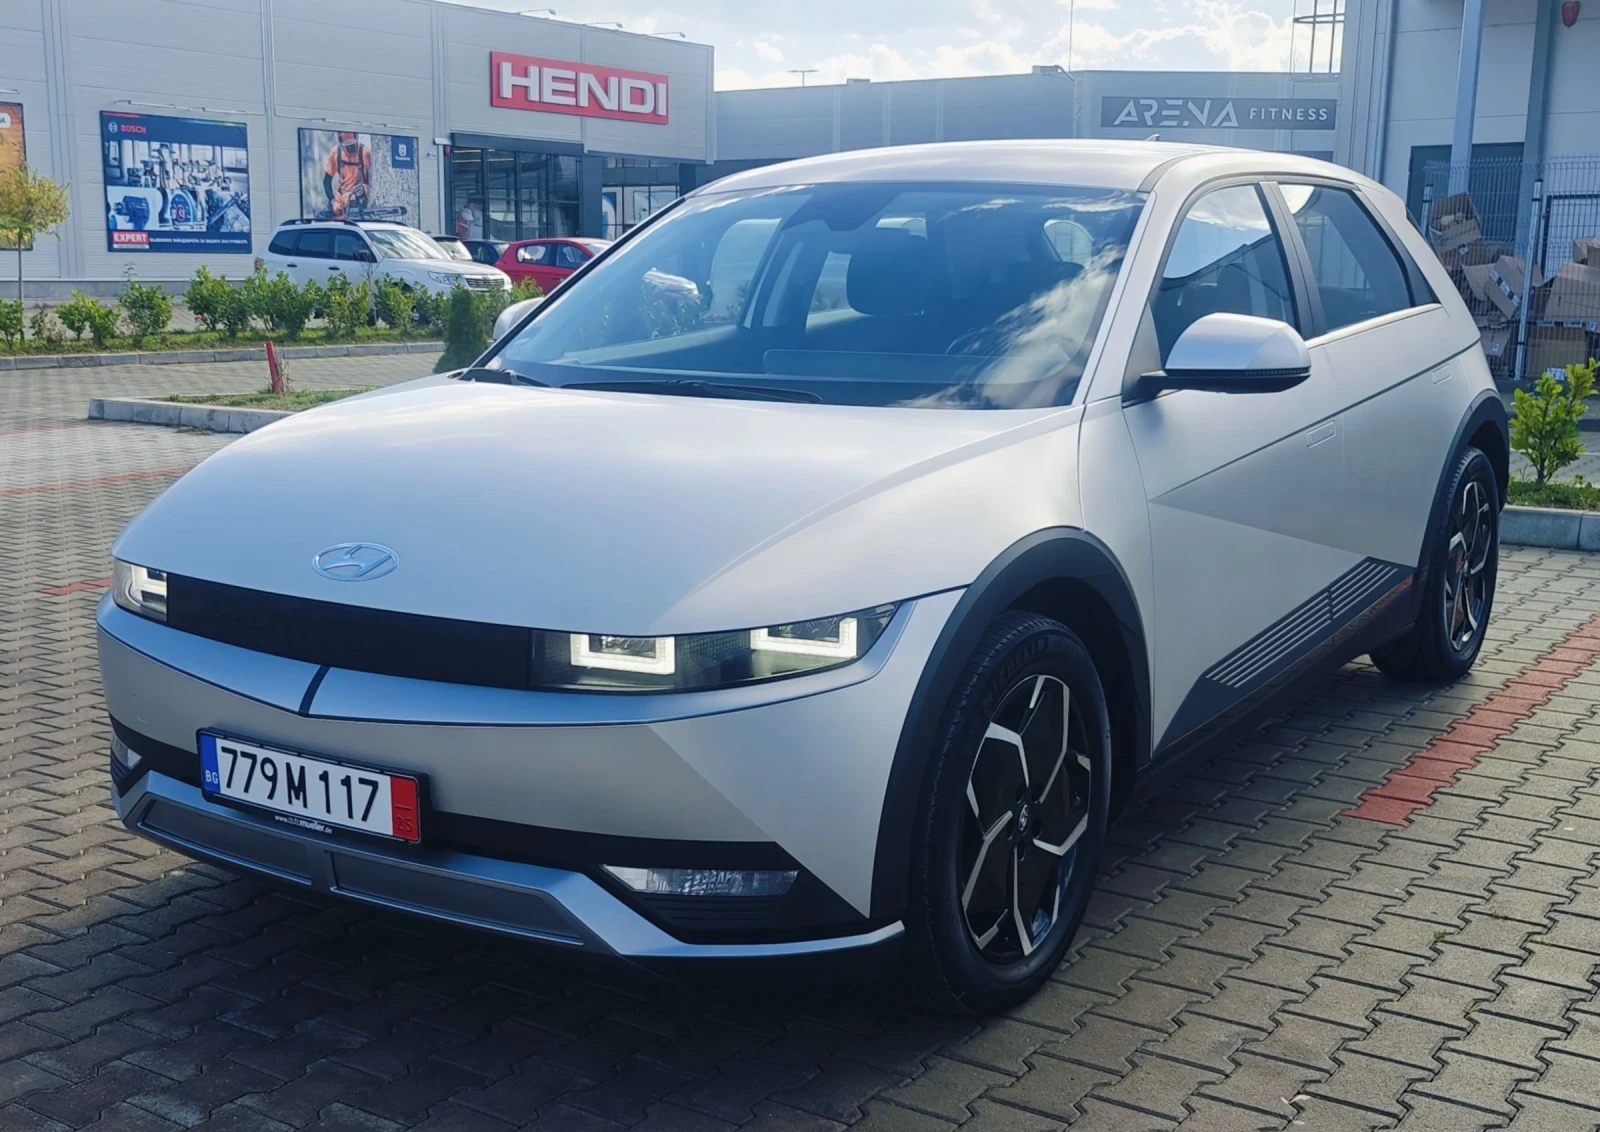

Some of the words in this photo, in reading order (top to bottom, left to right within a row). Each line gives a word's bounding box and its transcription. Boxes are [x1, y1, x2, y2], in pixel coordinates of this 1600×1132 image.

[500, 62, 667, 116] HENDI
[1113, 99, 1239, 127] ARENA
[1250, 107, 1328, 121] FITNESS
[120, 124, 146, 134] BOSCH
[113, 233, 148, 243] EXPERT
[205, 769, 218, 785] BG
[274, 814, 333, 834] www.automueller.de
